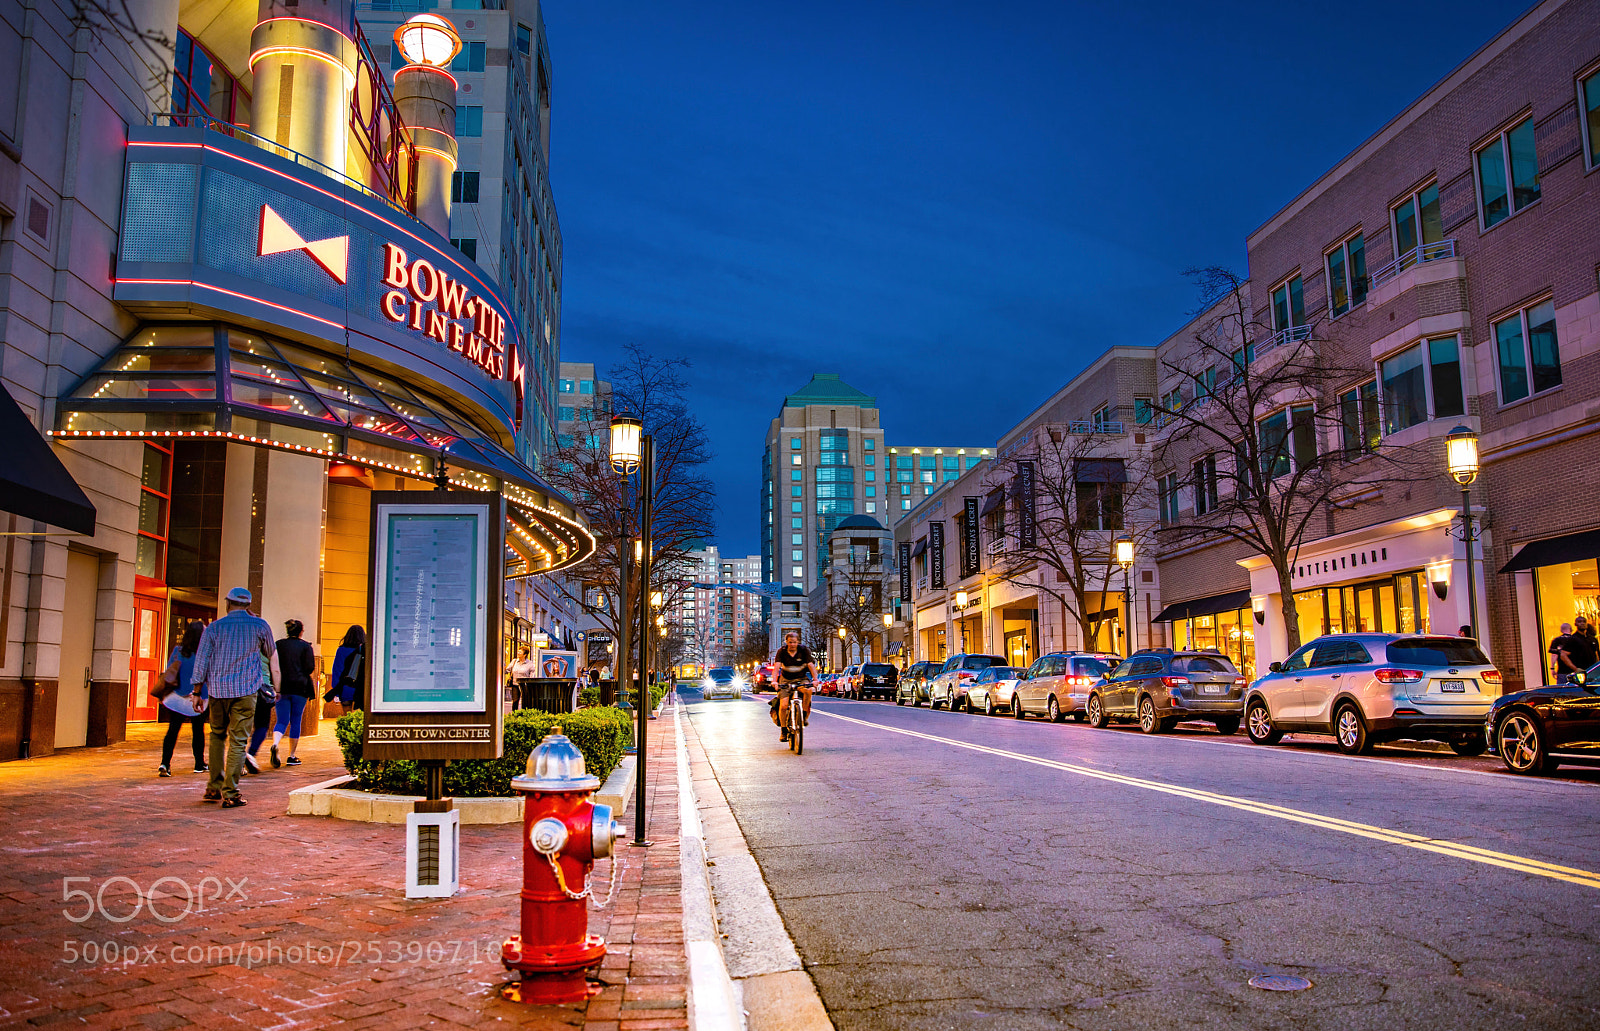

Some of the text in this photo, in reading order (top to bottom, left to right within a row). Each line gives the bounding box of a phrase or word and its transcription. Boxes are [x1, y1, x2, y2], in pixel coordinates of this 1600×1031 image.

[380, 290, 504, 380] CINEMAS
[1022, 466, 1031, 495] SECRET
[968, 501, 977, 569] VICTORIA'S SECRET
[368, 728, 490, 739] RESTON TOWN CENTER
